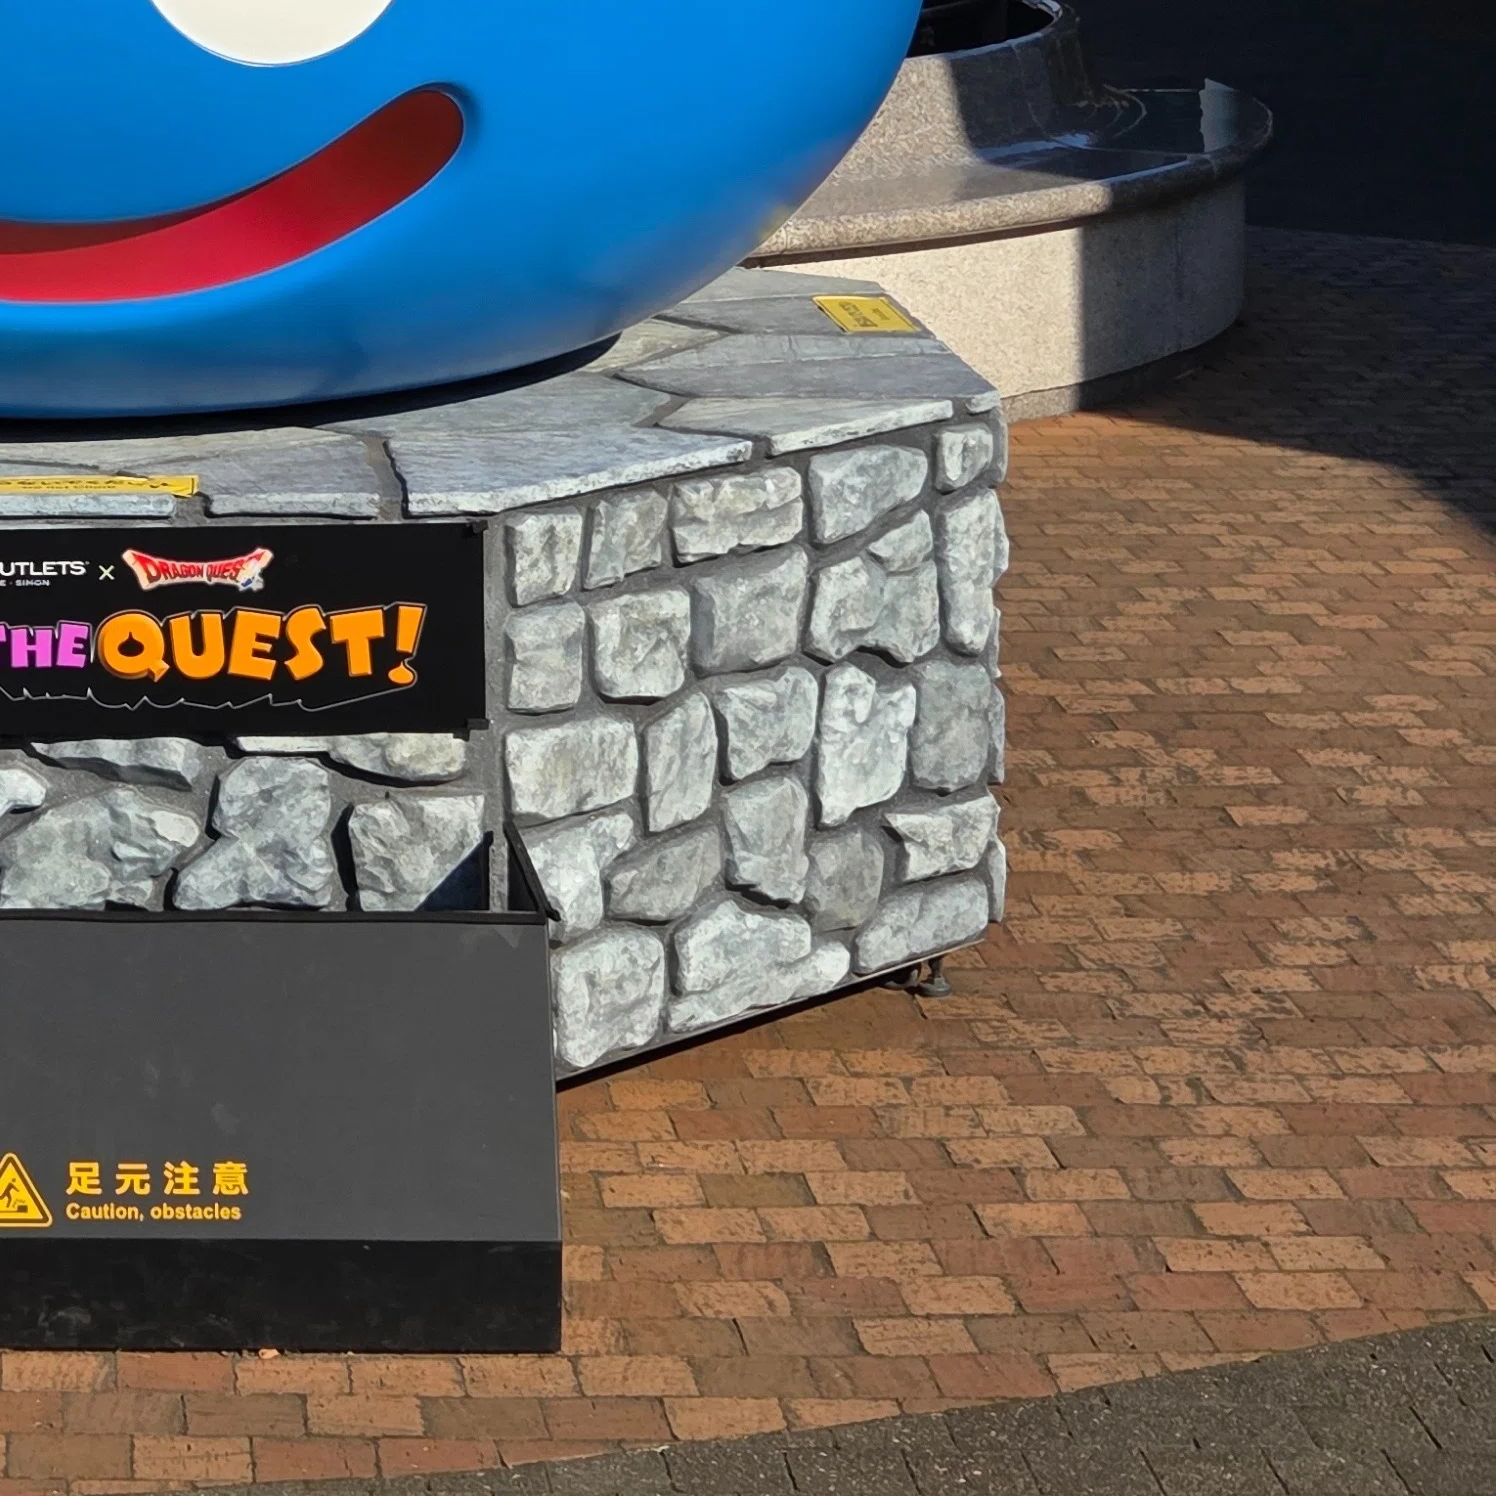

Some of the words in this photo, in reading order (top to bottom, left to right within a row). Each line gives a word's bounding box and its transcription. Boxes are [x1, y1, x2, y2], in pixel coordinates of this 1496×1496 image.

[15, 579, 50, 587] SIMON
[132, 552, 204, 584] DRAGON
[97, 604, 424, 684] QUEST!
[65, 1160, 250, 1196] 足元注意
[65, 1202, 145, 1222] Caution,
[150, 1202, 243, 1221] obstacles
